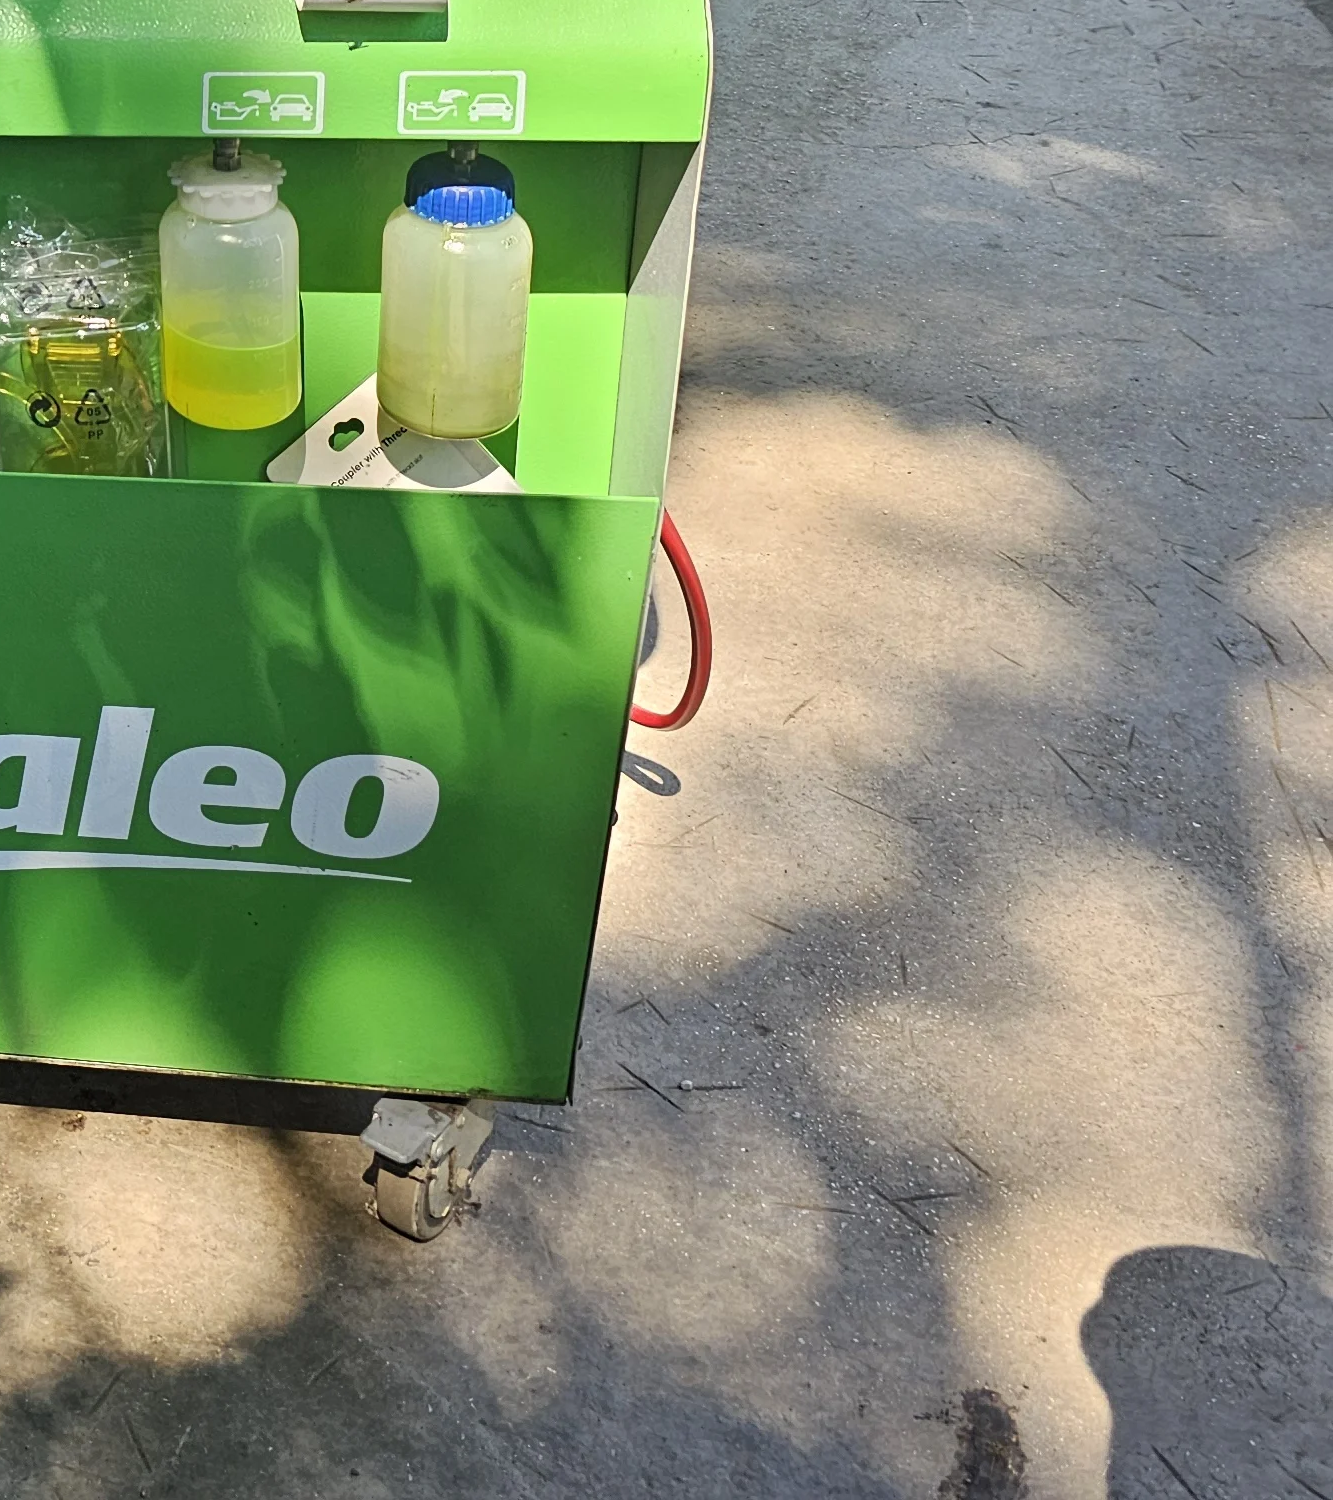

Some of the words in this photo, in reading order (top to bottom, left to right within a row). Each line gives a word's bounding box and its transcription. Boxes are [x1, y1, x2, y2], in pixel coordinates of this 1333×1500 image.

[86, 406, 101, 417] 05
[88, 429, 104, 440] PP
[331, 462, 365, 488] Coupler
